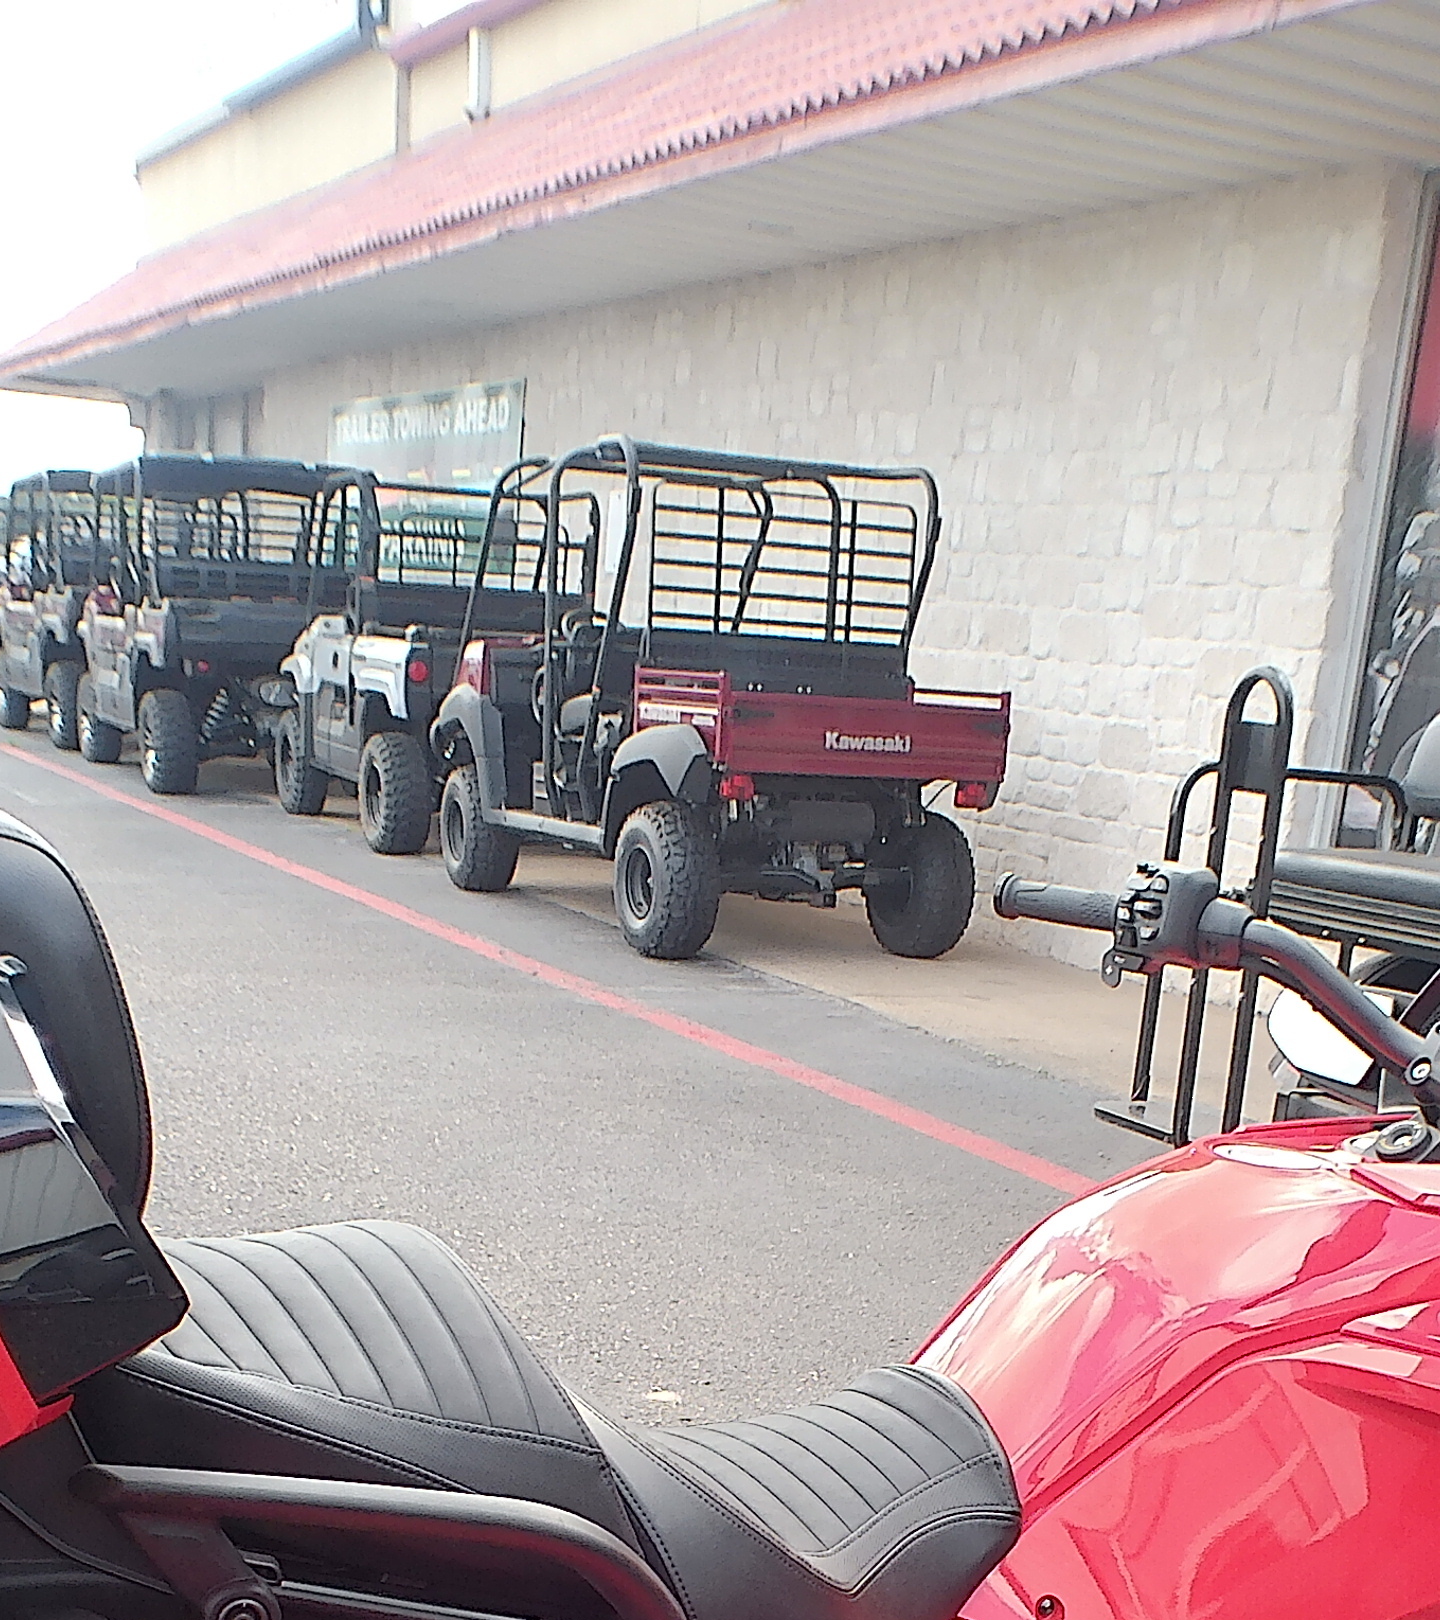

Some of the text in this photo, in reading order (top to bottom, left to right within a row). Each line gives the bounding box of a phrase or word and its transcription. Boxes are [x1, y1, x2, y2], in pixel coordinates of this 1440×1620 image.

[335, 394, 510, 447] TRAILER TOWING AHEAD
[824, 730, 912, 753] Kawasaki
